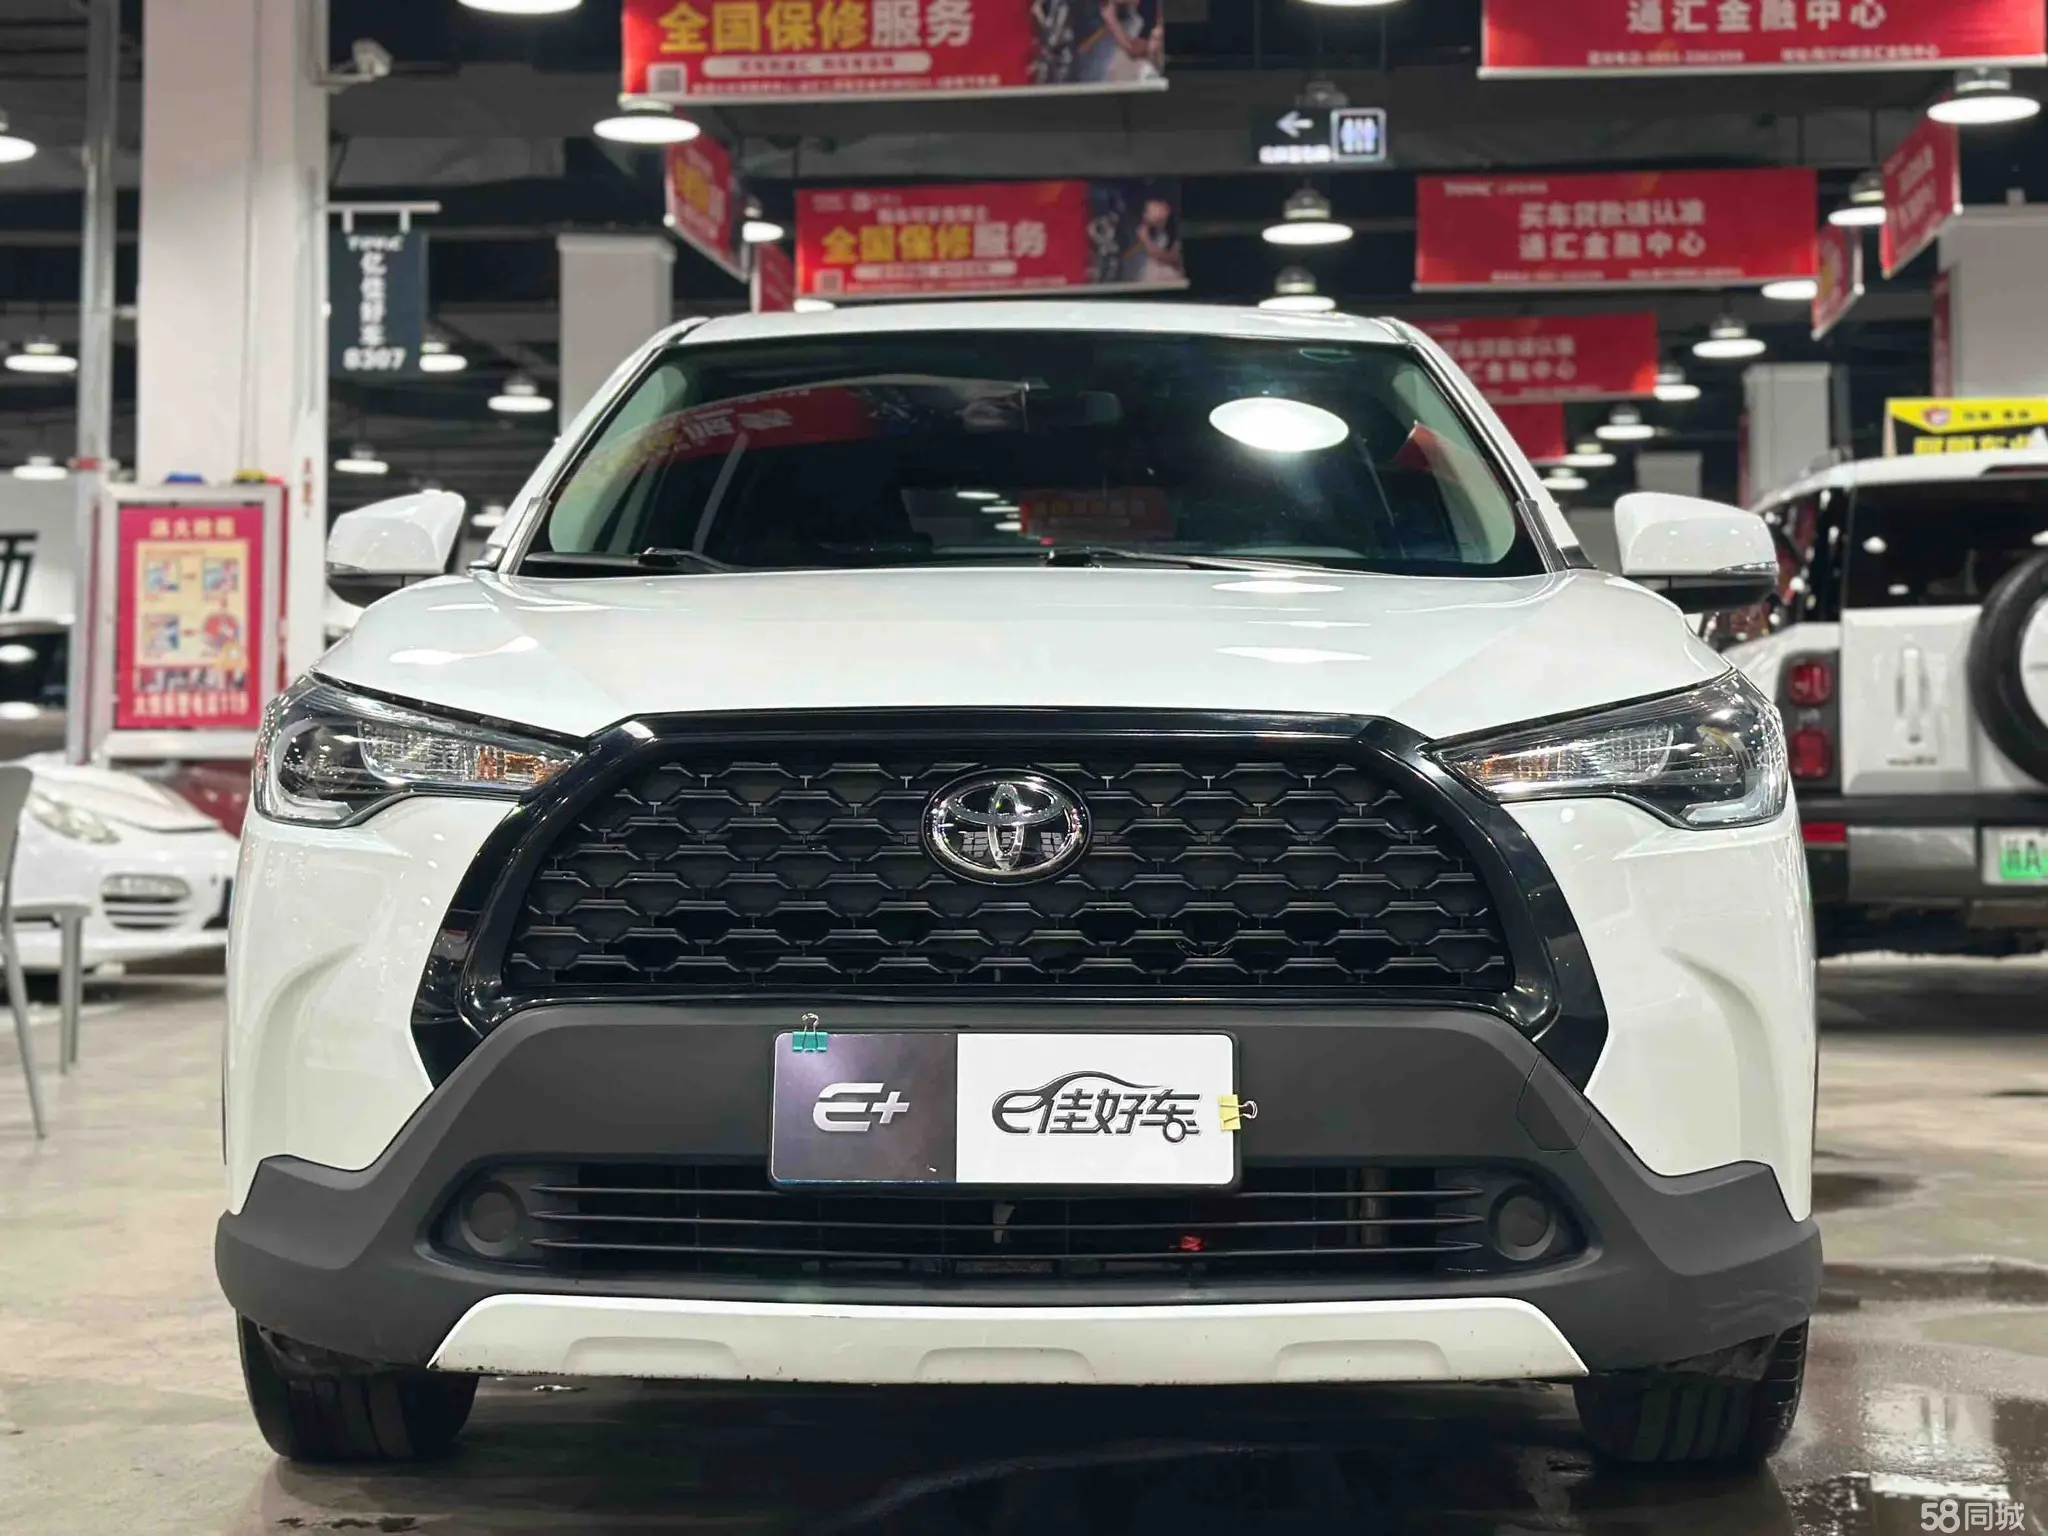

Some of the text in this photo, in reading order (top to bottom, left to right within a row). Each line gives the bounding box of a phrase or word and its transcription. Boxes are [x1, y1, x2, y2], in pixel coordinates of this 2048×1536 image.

[658, 0, 976, 53] 全国保修服务
[1627, 0, 1888, 34] 通汇金融中心
[1519, 199, 1706, 229] 买车贷款请认准
[821, 221, 1048, 264] 全国保修服务
[1519, 232, 1706, 261] 通汇金融中心
[812, 1082, 910, 1132] E+
